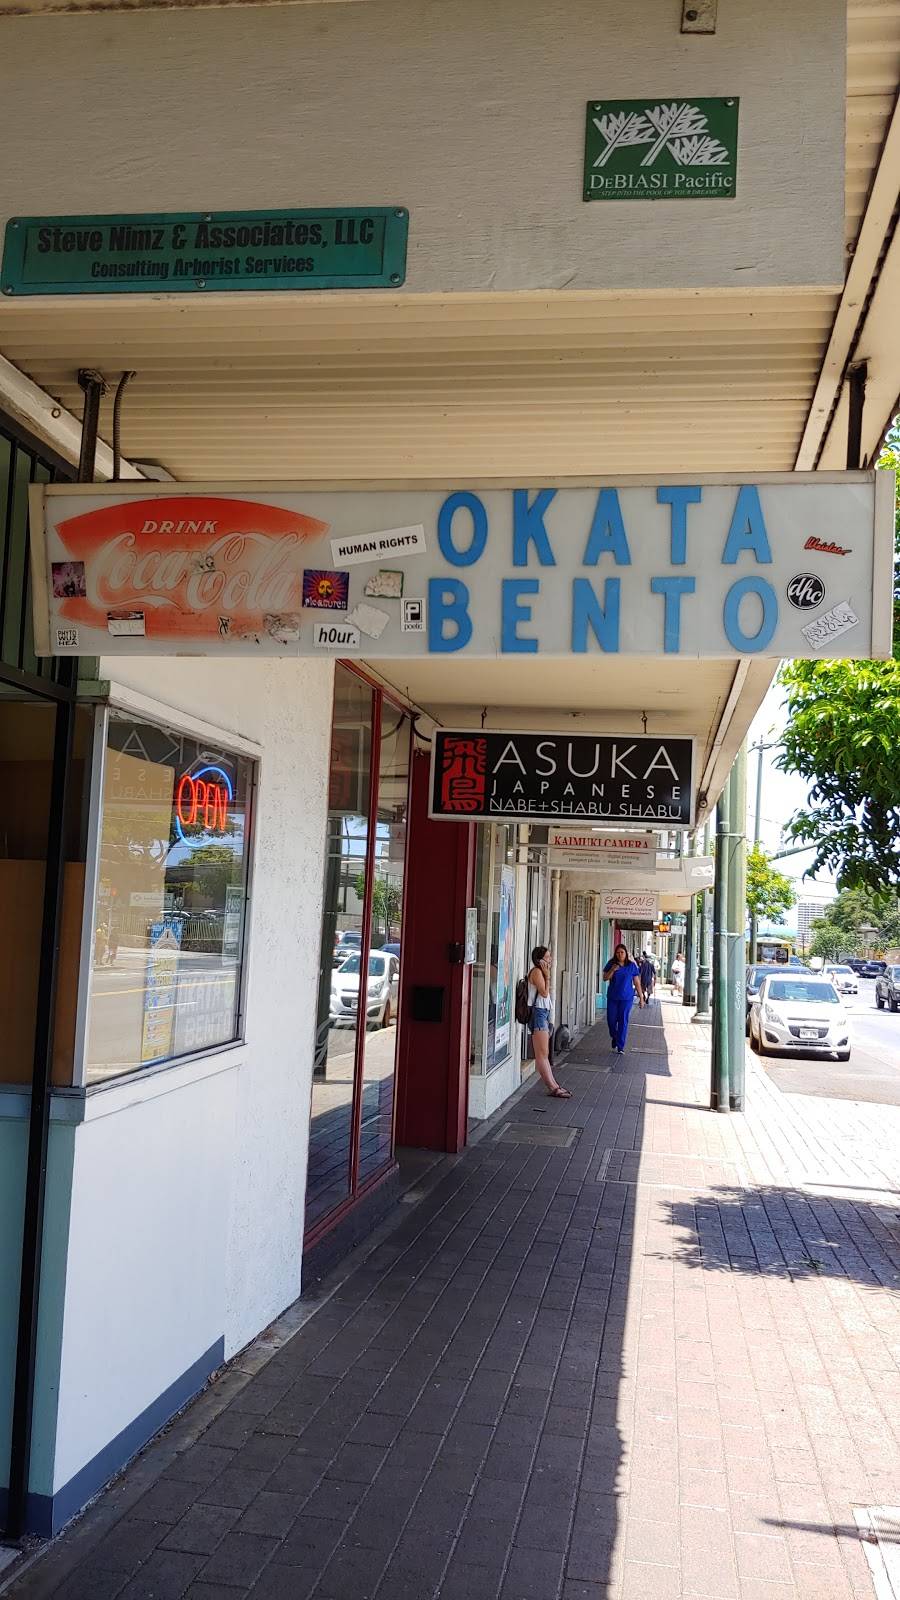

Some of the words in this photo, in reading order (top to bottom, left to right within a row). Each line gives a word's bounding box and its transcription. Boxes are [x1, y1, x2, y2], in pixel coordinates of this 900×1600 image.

[674, 172, 733, 188] Pacific
[37, 227, 103, 253] Steve
[109, 225, 165, 251] Nimz
[172, 223, 187, 248] &
[199, 220, 328, 250] Associates,
[334, 218, 374, 245] LLC
[91, 260, 169, 280] Consulting
[172, 257, 240, 277] Arborist
[245, 255, 314, 274] Services
[141, 520, 219, 534] DRINK
[437, 484, 773, 567] OKATA
[338, 541, 377, 556] HUMAN
[379, 534, 418, 550] RIGHTS
[788, 577, 822, 607] dhc
[428, 576, 779, 653] BENTO
[404, 622, 422, 631] poetic
[492, 740, 679, 781] ASUKA
[491, 780, 681, 800] JAPANESE
[178, 773, 228, 833] OPEN
[490, 797, 612, 816] NABE+SHABU
[619, 803, 681, 819] SHABU
[554, 836, 602, 847] KAIMUKI
[604, 838, 648, 849] CAMERA
